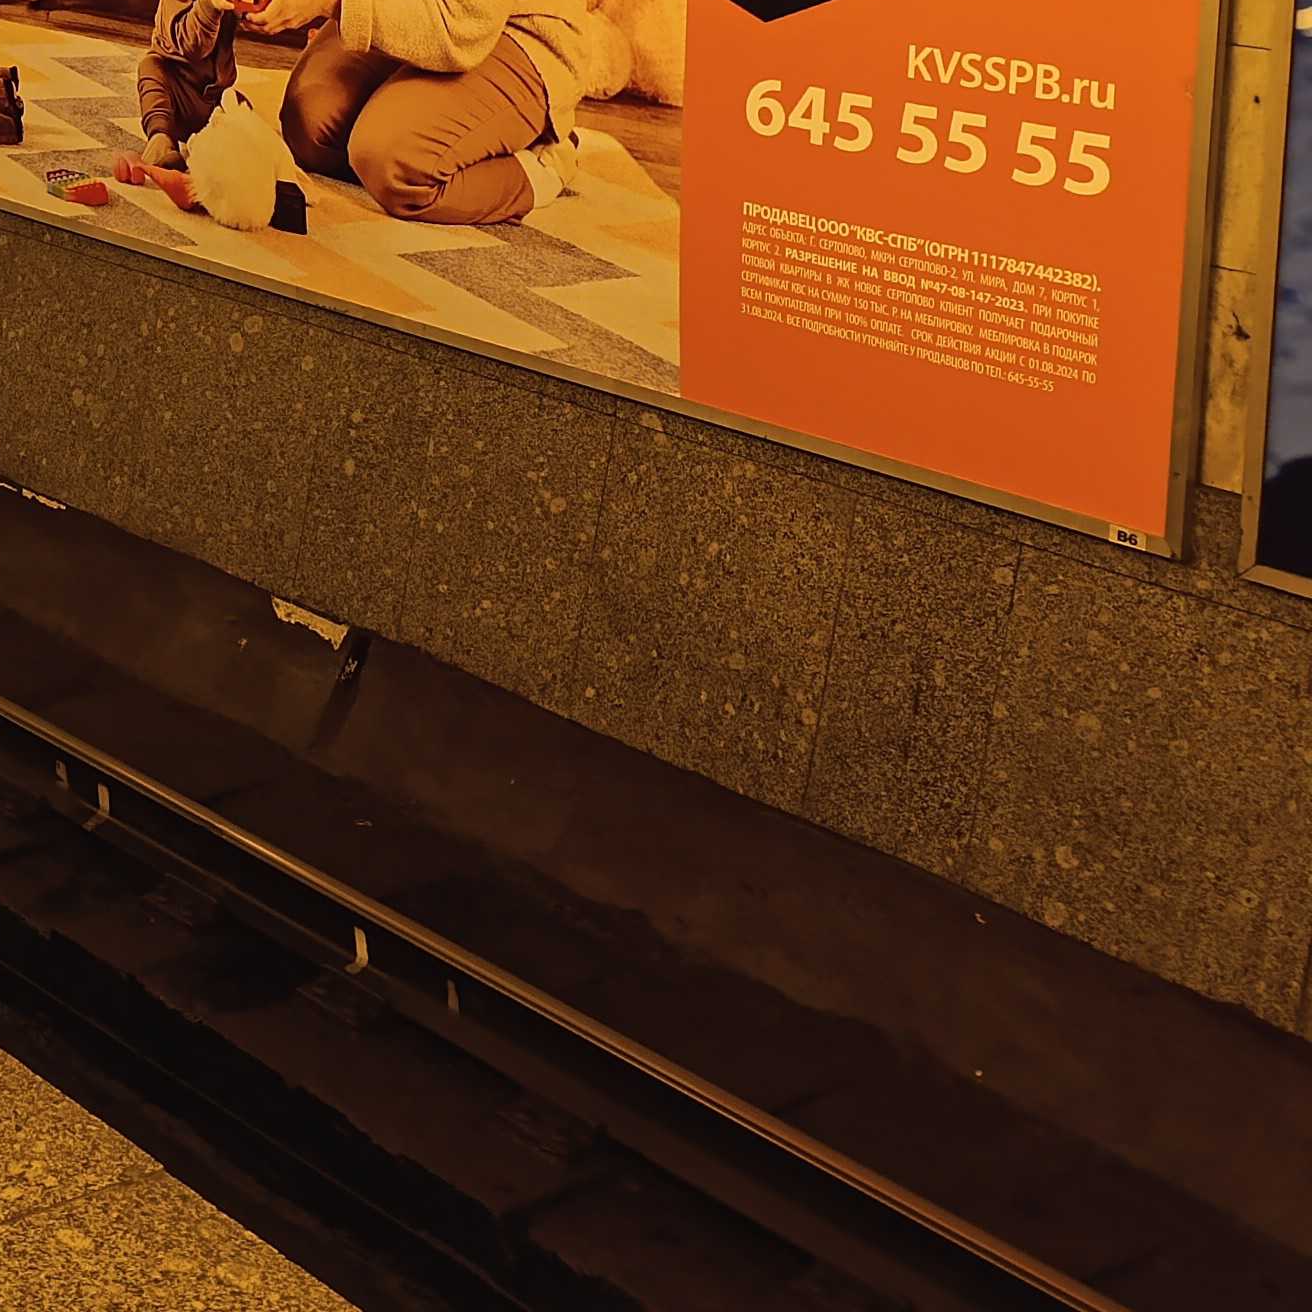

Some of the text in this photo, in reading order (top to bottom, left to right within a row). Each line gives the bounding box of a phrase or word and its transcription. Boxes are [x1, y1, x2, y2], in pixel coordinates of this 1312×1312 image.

[907, 44, 1116, 110] KVSSPB.ru
[745, 79, 1111, 197] 645 55 55
[742, 221, 767, 237] АДРЕС
[769, 227, 807, 245] ОБЪЕКТА:
[871, 249, 895, 265] МКРН
[1012, 280, 1035, 296] ДОМ
[1052, 289, 1088, 308] КОРПУС
[742, 237, 771, 254] КОРПУС
[785, 247, 857, 274] РАЗРЕШЕНИЕ
[862, 265, 878, 279] НА
[883, 269, 916, 289] ВВОД
[1032, 303, 1052, 318] ПРИ
[1056, 308, 1099, 330] ПОКУПКЕ
[743, 201, 816, 233] ПРОДАВЕЦ
[817, 218, 849, 237] ООО
[925, 240, 969, 263] (ОГРН
[971, 251, 1101, 292] 1117847442382).
[741, 270, 789, 291] СЕРТИФИКАТ
[791, 282, 806, 295] КВС
[808, 287, 819, 299] НА
[821, 289, 851, 306] СУММУ
[854, 298, 868, 311] 150
[900, 308, 912, 321] НА
[979, 327, 1041, 353] МЕБЛИРОВКА
[1052, 344, 1097, 366] ПОДАРОК
[741, 286, 763, 301] ВСЕМ
[765, 292, 822, 316] ПОКУПАТЕЛЯМ
[825, 307, 842, 320] ПРИ
[845, 312, 868, 328] 100%
[911, 328, 933, 344] СРОК
[936, 334, 982, 356] ДЕЙСТВИЯ
[984, 346, 1016, 365] АКЦИИ
[1028, 357, 1078, 379] 01.08.2024
[1082, 370, 1096, 384] ПО
[742, 253, 775, 271] ГОТОВОЙ
[780, 260, 822, 282] КВАРТИРЫ
[836, 276, 850, 289] ЖК
[854, 279, 882, 297] НОВОЕ
[887, 288, 935, 309] СЕРТОЛОВО
[939, 300, 975, 318] КЛИЕНТ
[979, 309, 1025, 330] ПОЛУЧАЕТ
[1030, 320, 1098, 347] ПОДАРОЧНЫЙ
[786, 314, 801, 328] ВСЕ
[802, 318, 861, 342] ПОДРОБНОСТИ
[861, 333, 909, 355] УТОЧНЯЙТЕ
[917, 345, 970, 371] ПРОДАВЦОВ
[971, 360, 984, 375] ПО
[1007, 371, 1054, 392] 645-55-55
[1117, 530, 1138, 546] B6
